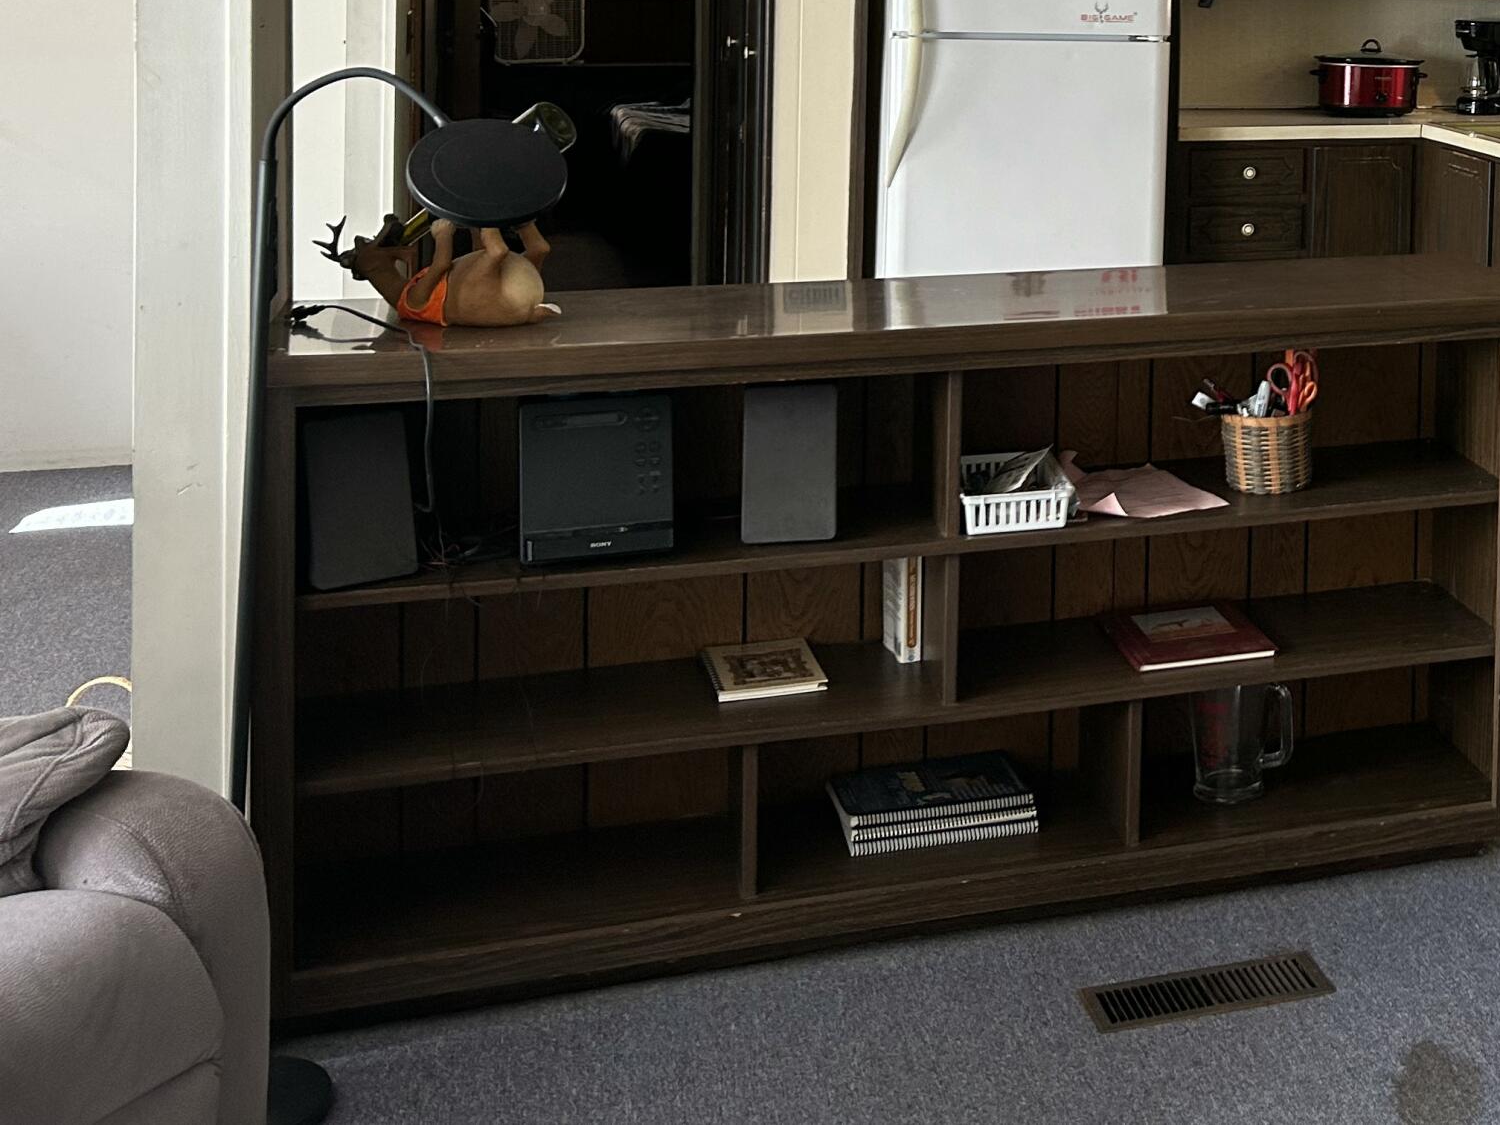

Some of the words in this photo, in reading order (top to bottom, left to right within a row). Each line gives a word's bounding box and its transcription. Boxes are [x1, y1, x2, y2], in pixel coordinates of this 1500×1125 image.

[1080, 13, 1099, 22] BIG
[1103, 14, 1135, 23] GAME
[590, 540, 612, 548] SONY
